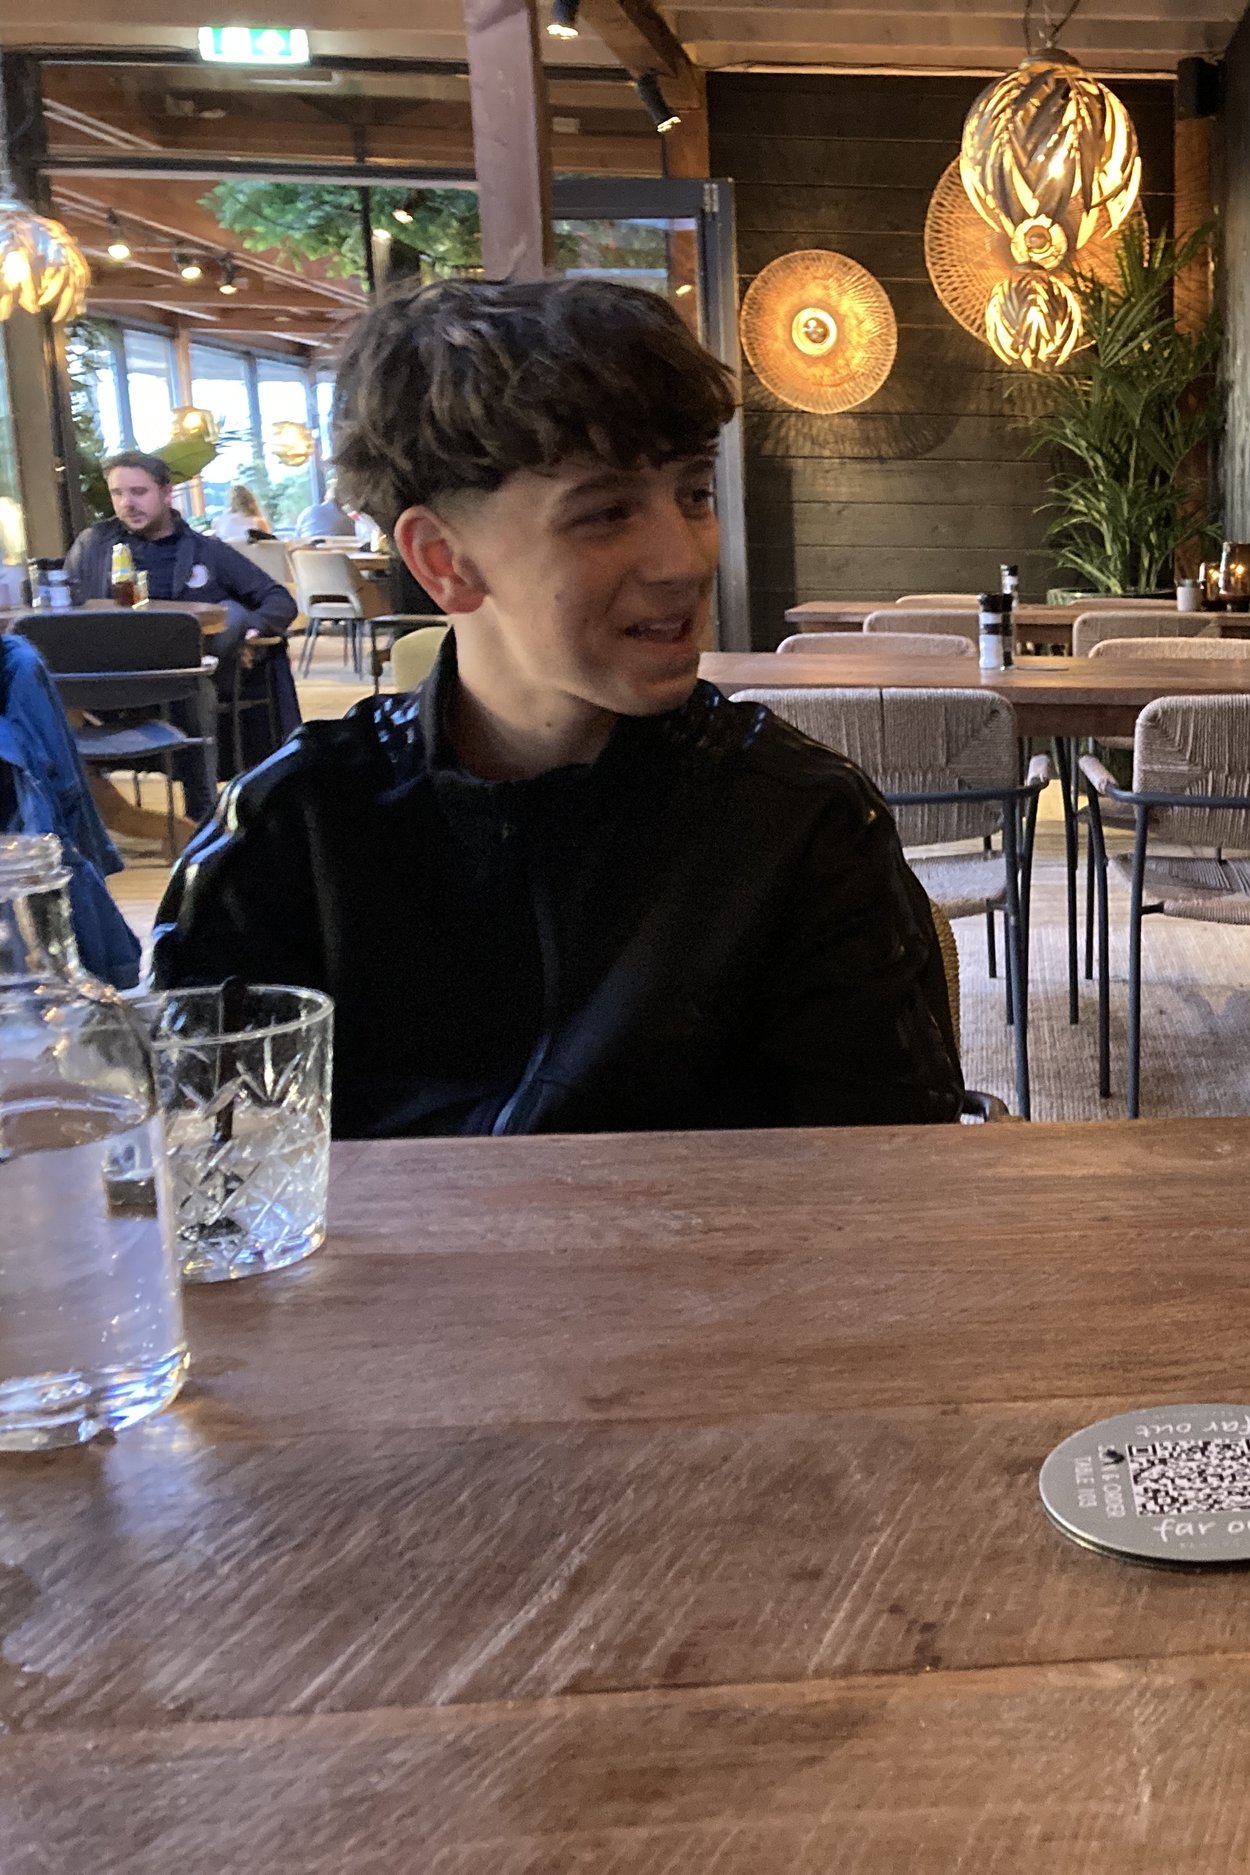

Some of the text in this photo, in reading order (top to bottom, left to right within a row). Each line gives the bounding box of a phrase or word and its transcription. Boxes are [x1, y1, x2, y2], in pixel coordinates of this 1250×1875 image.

[1135, 1422, 1192, 1438] out
[1074, 1456, 1095, 1485] TABLE
[1103, 1483, 1126, 1518] ORDER
[1153, 1518, 1217, 1543] far
